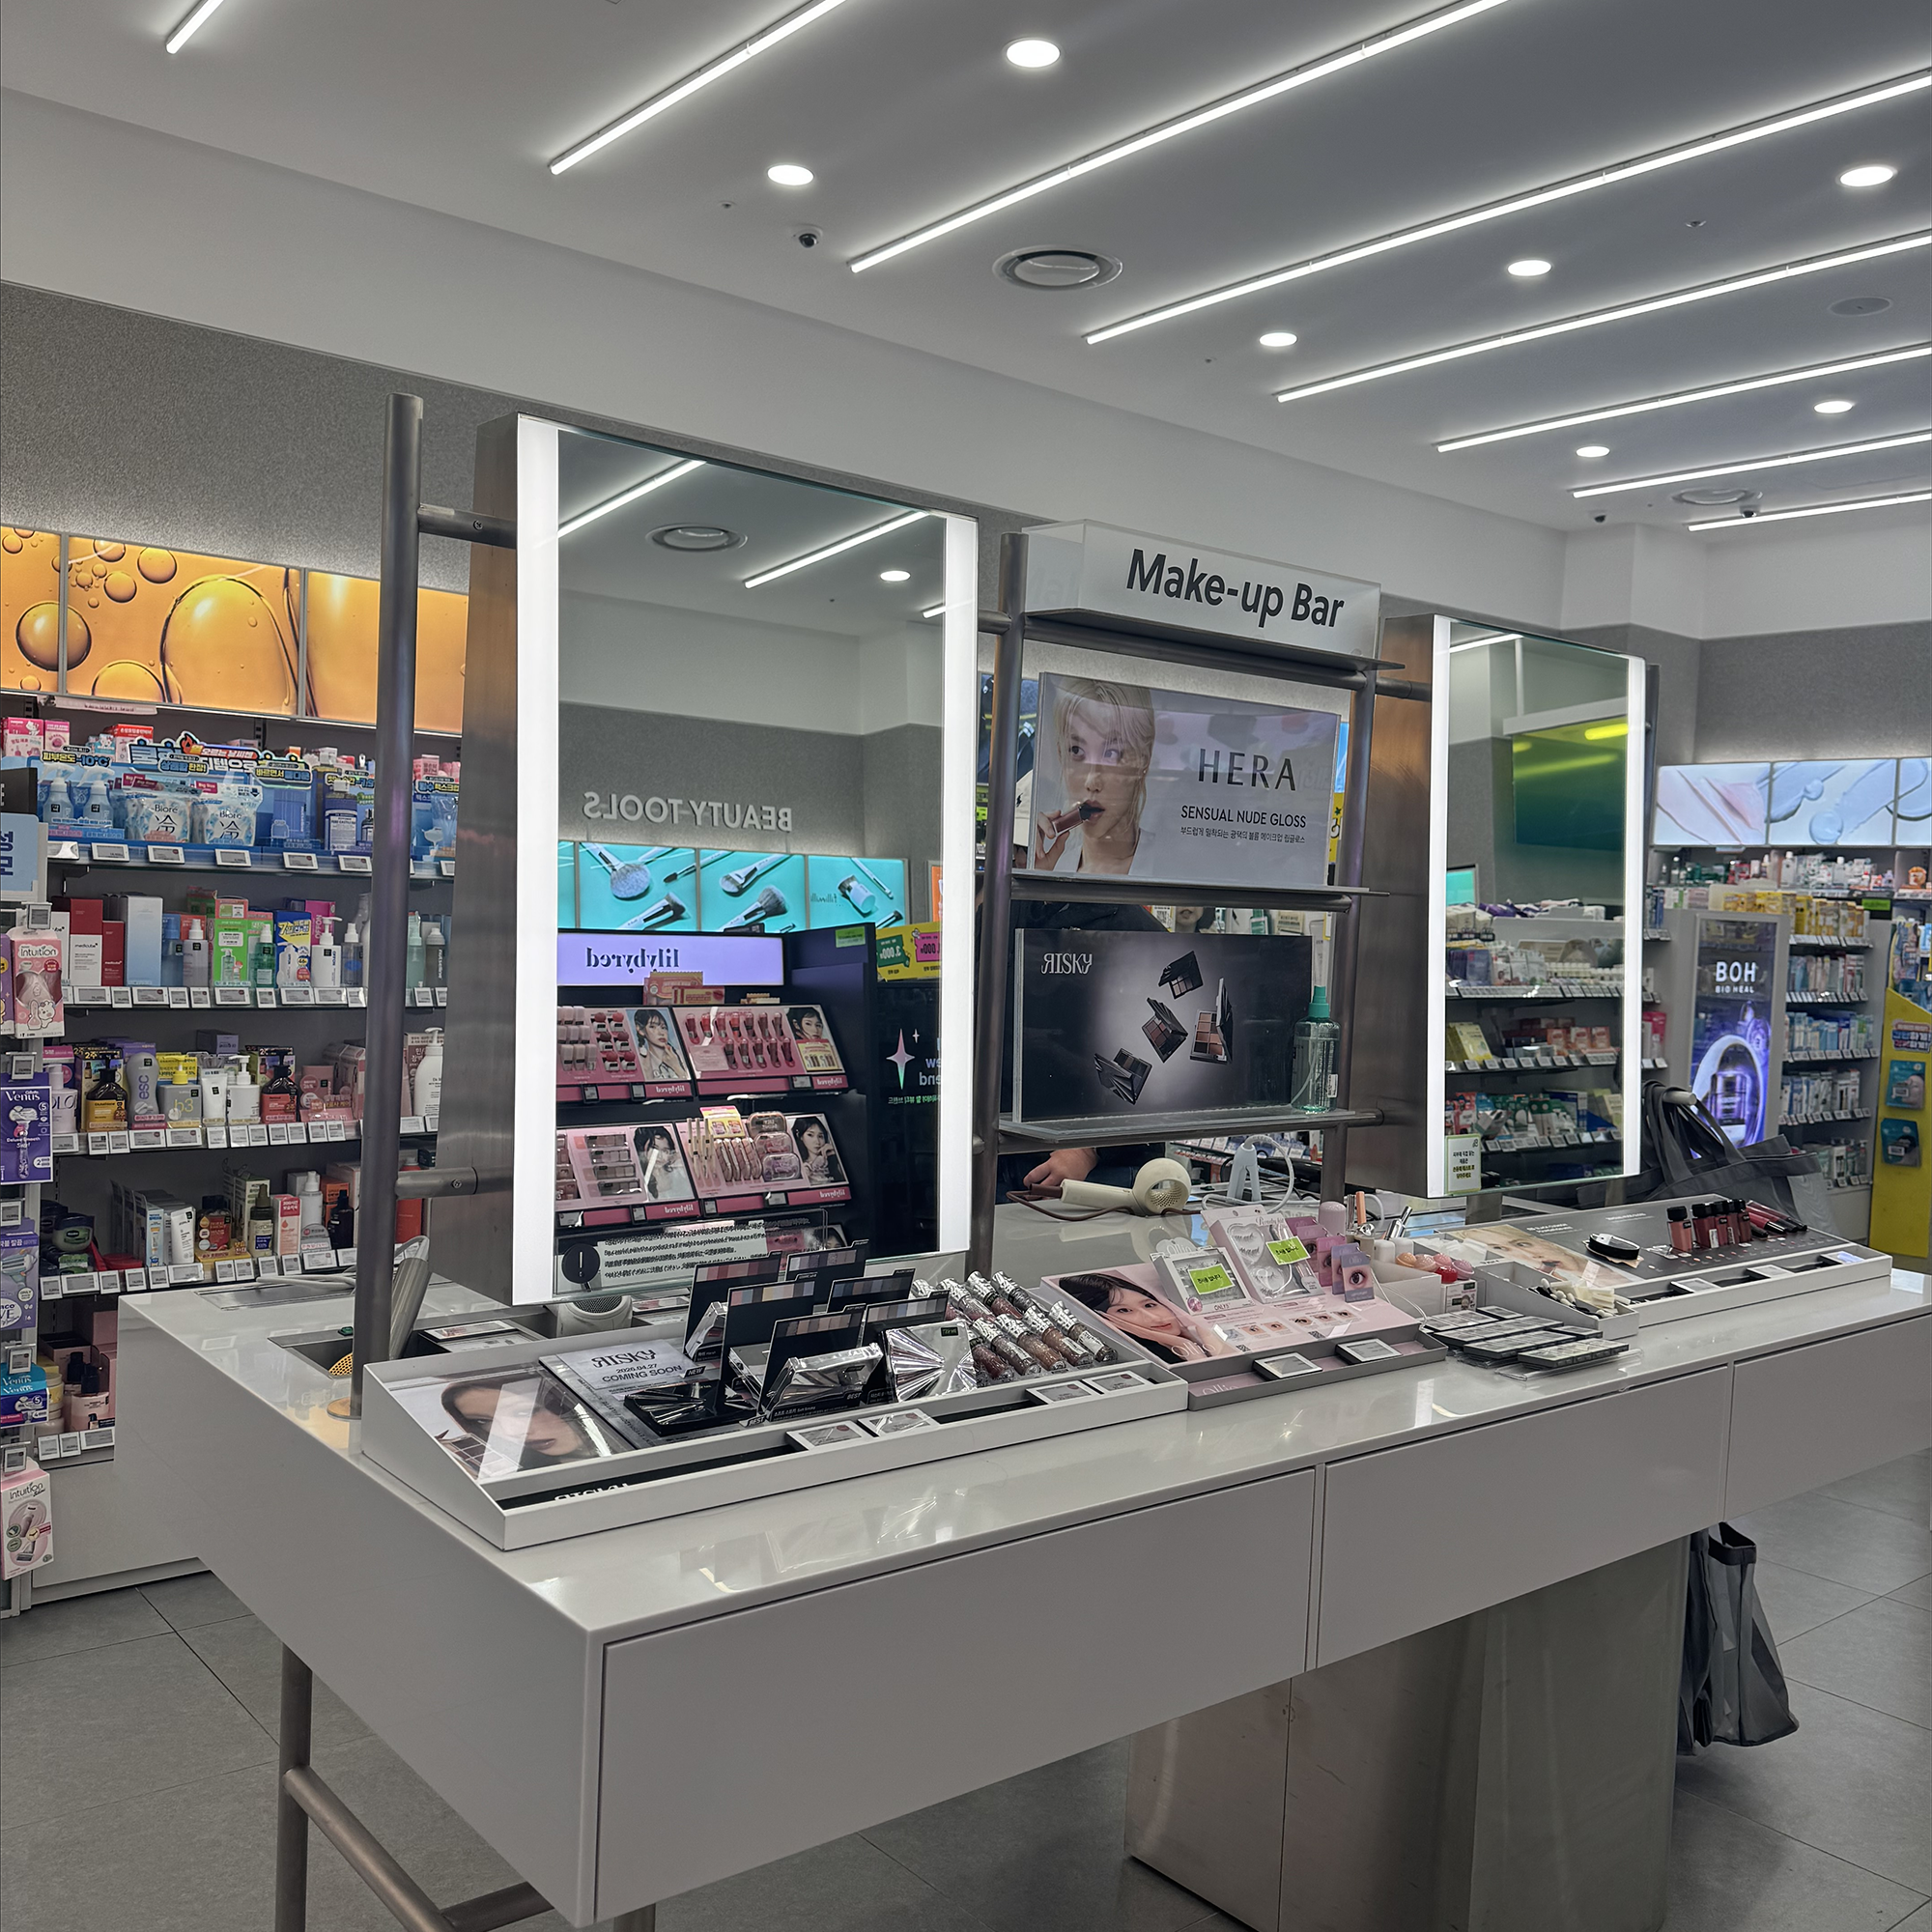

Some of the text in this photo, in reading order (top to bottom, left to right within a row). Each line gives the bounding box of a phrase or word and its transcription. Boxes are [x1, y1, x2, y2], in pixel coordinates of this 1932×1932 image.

[1126, 549, 1346, 628] Make-up Bar
[1198, 748, 1296, 791] HERA
[1180, 805, 1307, 828] SENSUAL NUDE GLOSS
[1180, 826, 1205, 837] 부드럽게
[1715, 961, 1757, 983] BOH
[1715, 984, 1754, 994] BIO HEAL
[138, 1074, 150, 1099] esc
[6, 1091, 41, 1101] Venus
[602, 1365, 683, 1382] COMING SOON
[688, 1367, 703, 1376] NEW
[750, 1416, 766, 1426] BEST
